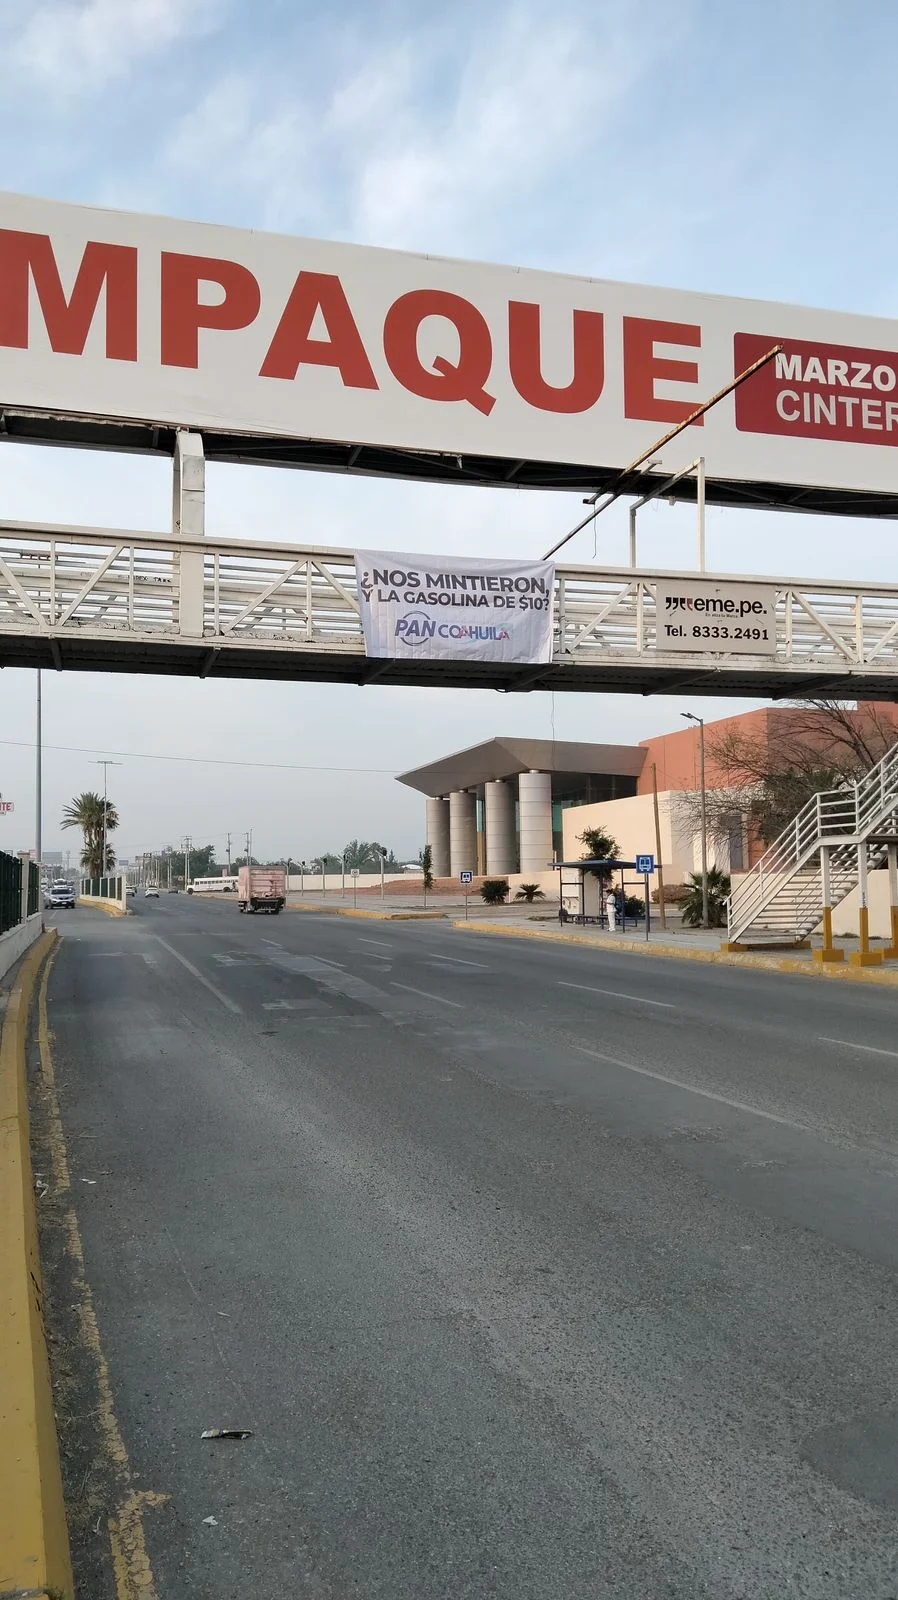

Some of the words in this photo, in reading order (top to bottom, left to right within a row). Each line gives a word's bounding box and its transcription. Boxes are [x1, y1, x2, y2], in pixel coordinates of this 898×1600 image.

[0, 229, 705, 426] MPAQUE
[775, 353, 896, 391] MARZO
[361, 569, 421, 589] ¿NOS
[425, 573, 550, 598] MINTIERON,
[361, 589, 373, 602] Y
[378, 589, 400, 603] LA
[403, 591, 489, 608] GASOLINA
[493, 595, 516, 609] DE
[519, 594, 550, 611] $10?
[394, 619, 436, 637] PAN
[438, 624, 511, 641] COAHUILA
[664, 624, 687, 637] Tel.
[692, 625, 769, 640] 8333.2491
